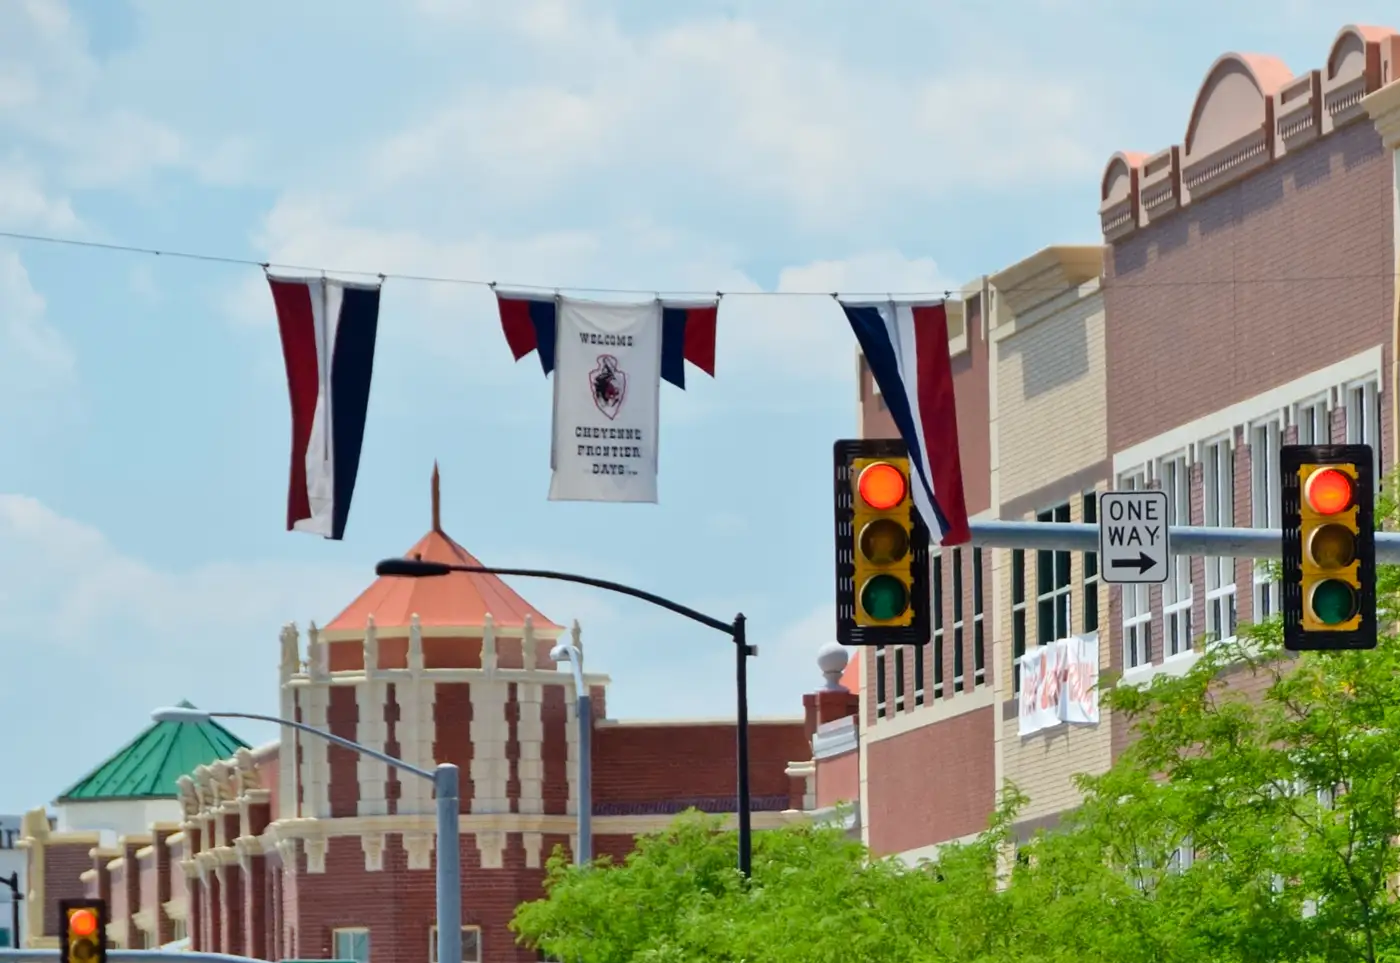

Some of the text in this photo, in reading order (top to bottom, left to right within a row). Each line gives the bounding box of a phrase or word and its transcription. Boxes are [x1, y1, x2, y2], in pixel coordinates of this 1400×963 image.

[579, 332, 633, 347] WELCOME
[575, 426, 642, 440] CHEYENNE
[577, 445, 641, 458] FRONTIER
[592, 464, 625, 475] DAYS
[1110, 500, 1158, 521] ONE
[1108, 526, 1160, 546] WAY
